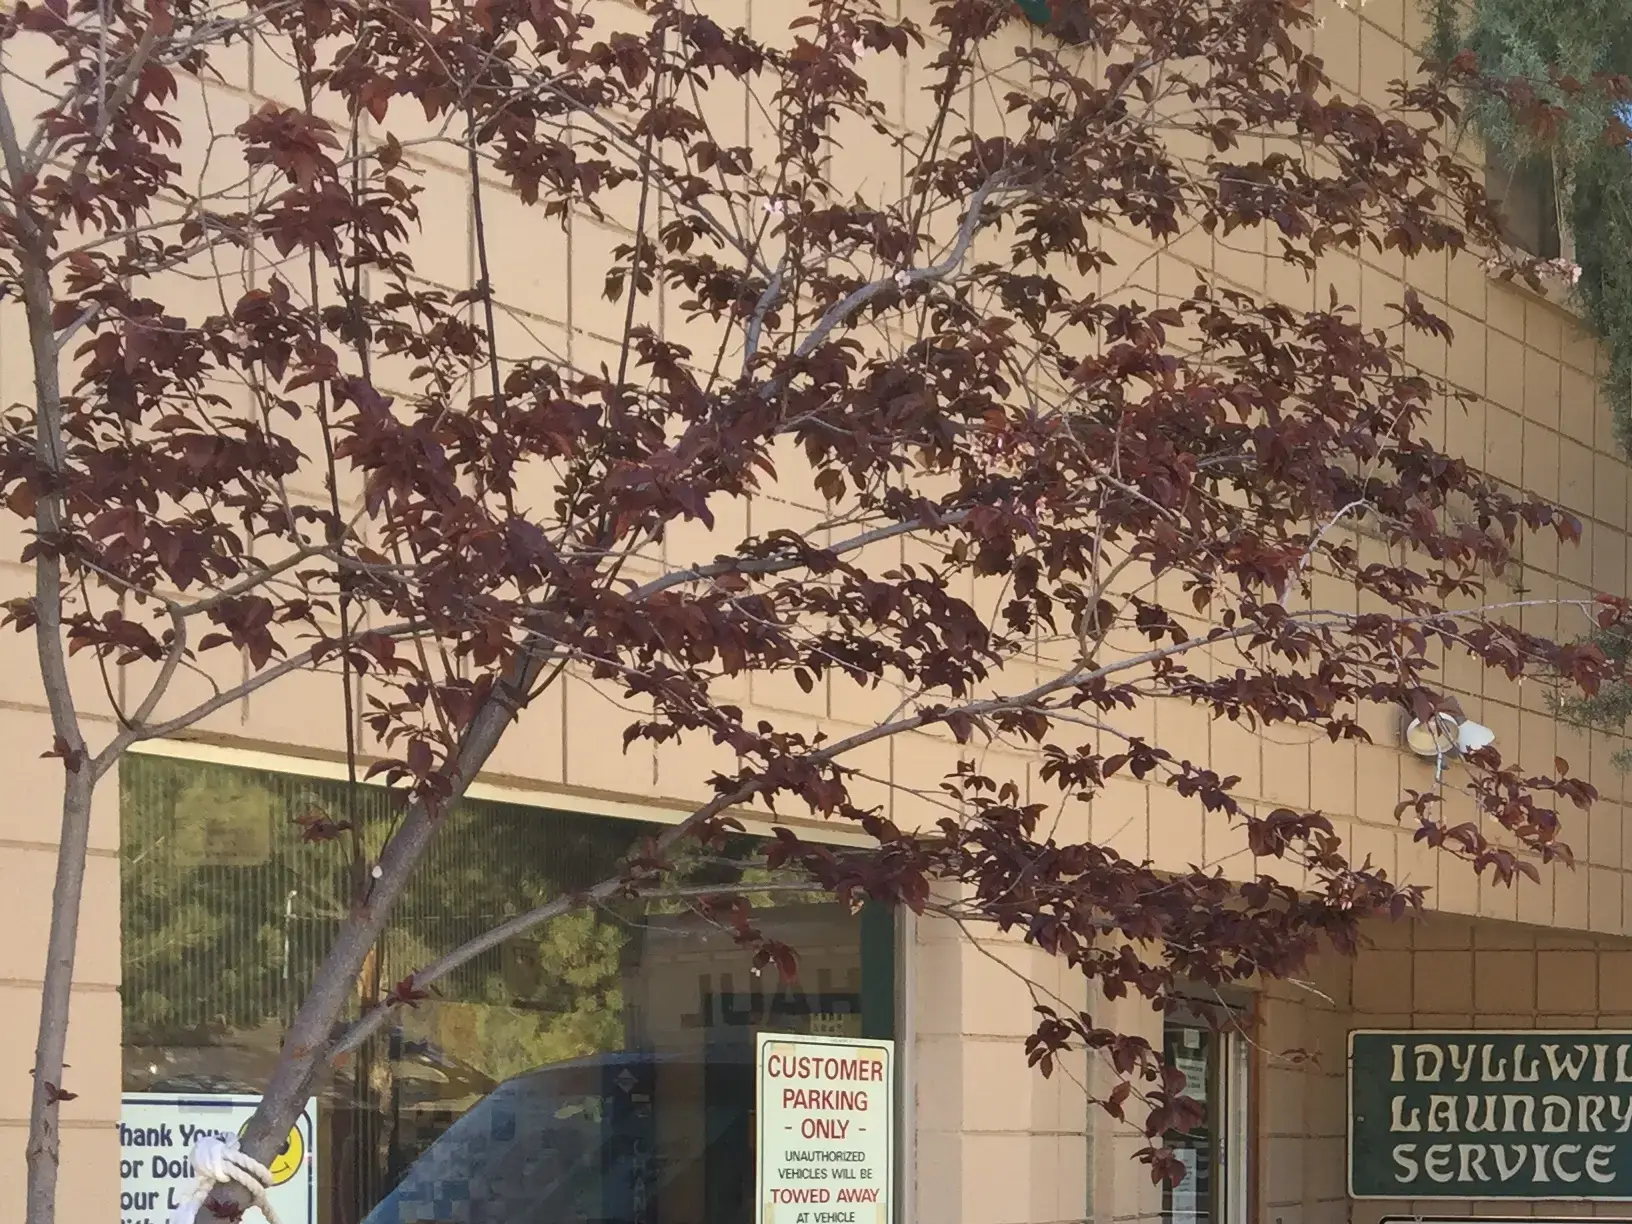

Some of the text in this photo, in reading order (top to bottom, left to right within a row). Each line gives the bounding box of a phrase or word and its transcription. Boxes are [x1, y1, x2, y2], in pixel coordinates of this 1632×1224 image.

[767, 1054, 884, 1082] CUSTOMER
[783, 1088, 869, 1112] PARKING
[117, 1123, 173, 1147] hank
[801, 1118, 850, 1140] ONLY
[119, 1155, 196, 1179] or Doi
[784, 1150, 866, 1163] UNAUTHORIZED
[1392, 1143, 1617, 1183] SERVICE
[778, 1168, 873, 1180] VEHICLES WILL BE
[120, 1191, 160, 1211] our
[770, 1187, 880, 1205] TOWED AWAY
[796, 1211, 856, 1224] AT VEHICLE
